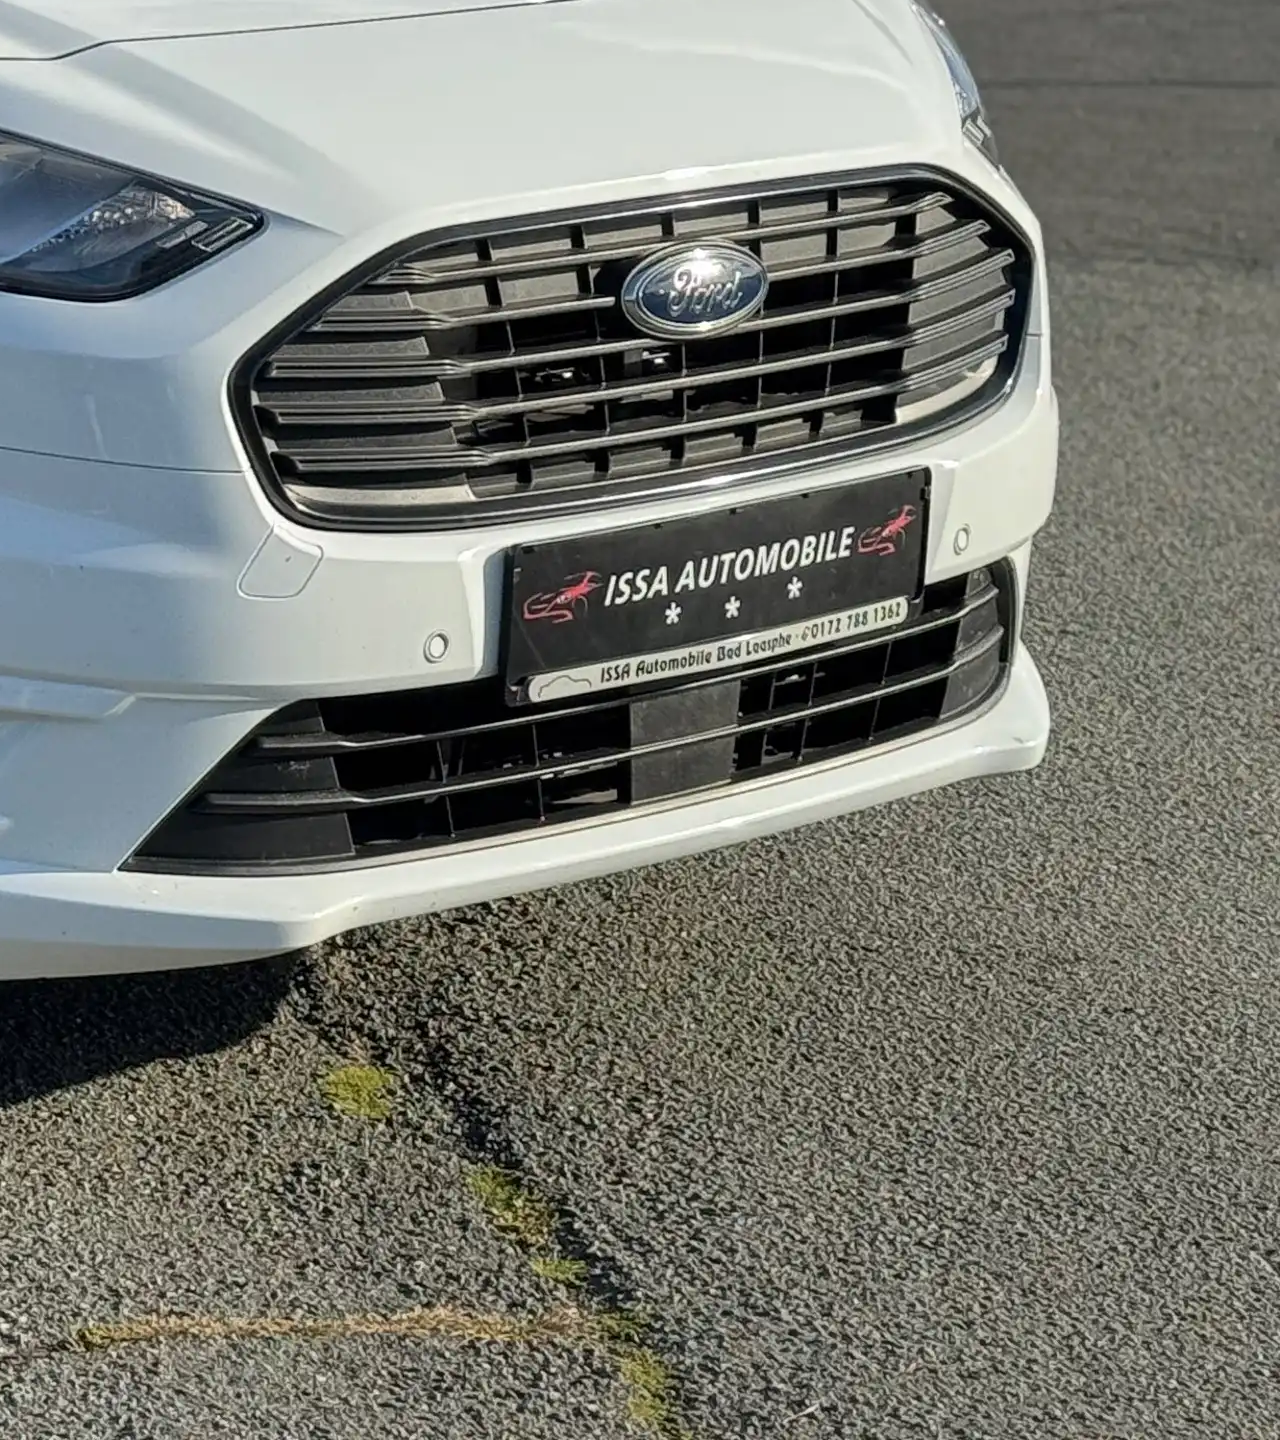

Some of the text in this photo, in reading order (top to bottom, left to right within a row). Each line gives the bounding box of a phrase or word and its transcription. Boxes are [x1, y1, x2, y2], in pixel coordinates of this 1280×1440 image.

[666, 265, 743, 317] Ford
[604, 526, 856, 607] ISSA AUTOMOBILE
[600, 662, 631, 683] ISSA
[635, 648, 712, 677] Automobile
[847, 610, 868, 629] 788
[874, 602, 901, 624] 1362
